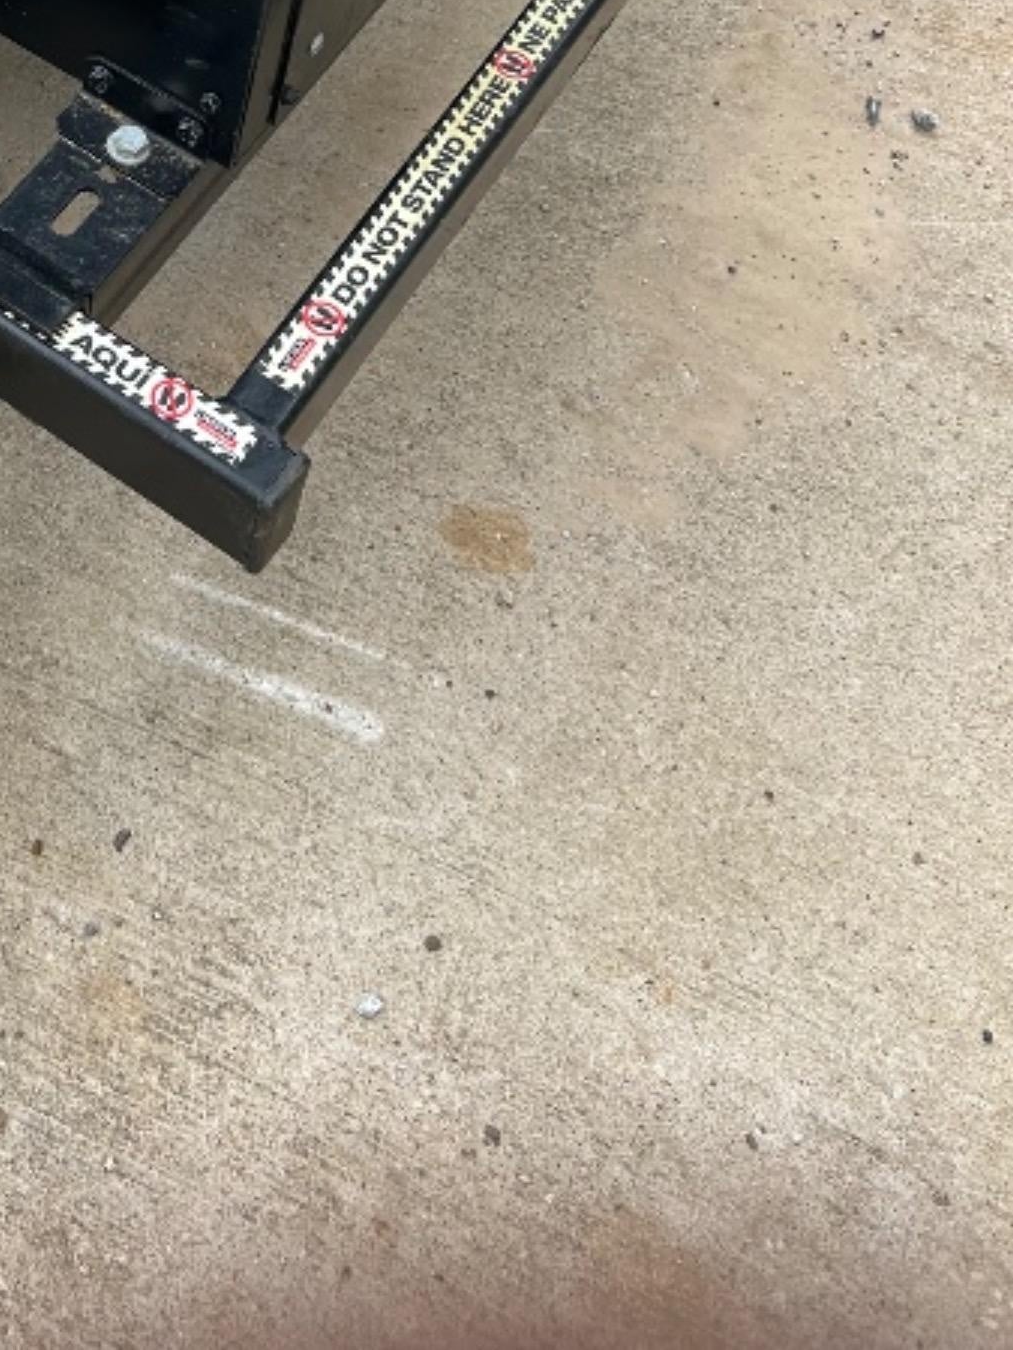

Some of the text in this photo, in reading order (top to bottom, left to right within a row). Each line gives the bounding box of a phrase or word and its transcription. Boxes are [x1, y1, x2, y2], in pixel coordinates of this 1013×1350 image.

[331, 265, 370, 306] DO
[362, 213, 408, 266] NOT
[401, 136, 467, 213] STAND
[459, 76, 511, 137] HERE
[518, 23, 549, 55] NE
